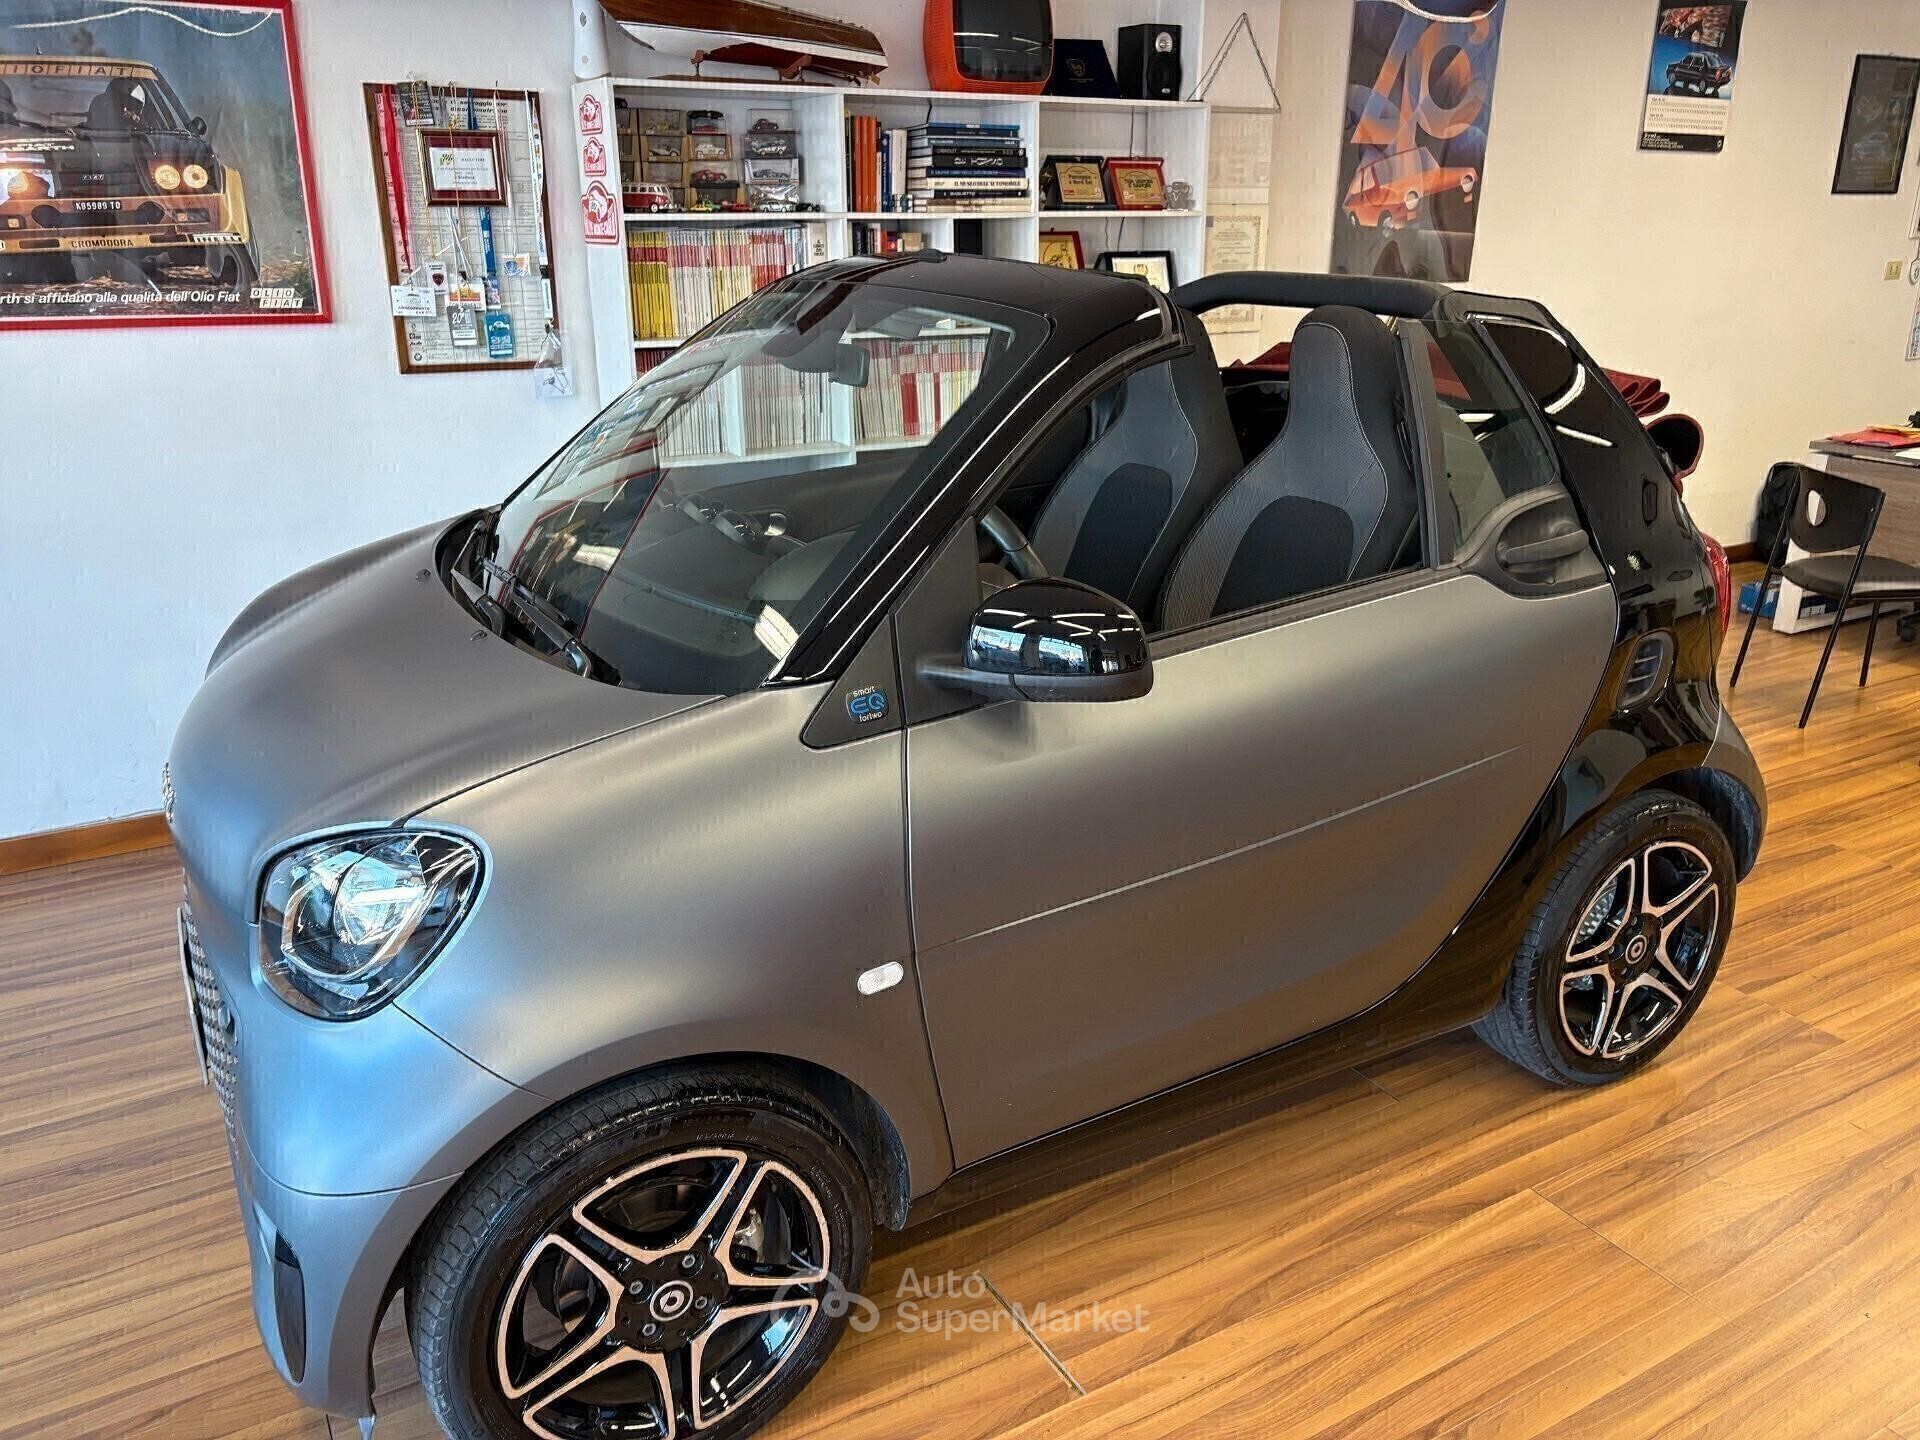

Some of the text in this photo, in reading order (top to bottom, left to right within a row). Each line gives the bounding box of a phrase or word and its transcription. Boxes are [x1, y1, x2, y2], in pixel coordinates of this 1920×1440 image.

[71, 239, 134, 248] CROMODORA
[24, 292, 36, 304] si
[38, 291, 92, 304] affidano
[95, 291, 118, 303] alla
[120, 290, 163, 305] qualità
[217, 290, 241, 302] Fiat
[252, 288, 294, 298] OLIO
[261, 299, 303, 308] FIAT
[852, 685, 876, 698] smart
[850, 692, 885, 714] EQ
[859, 711, 883, 723] fortwo
